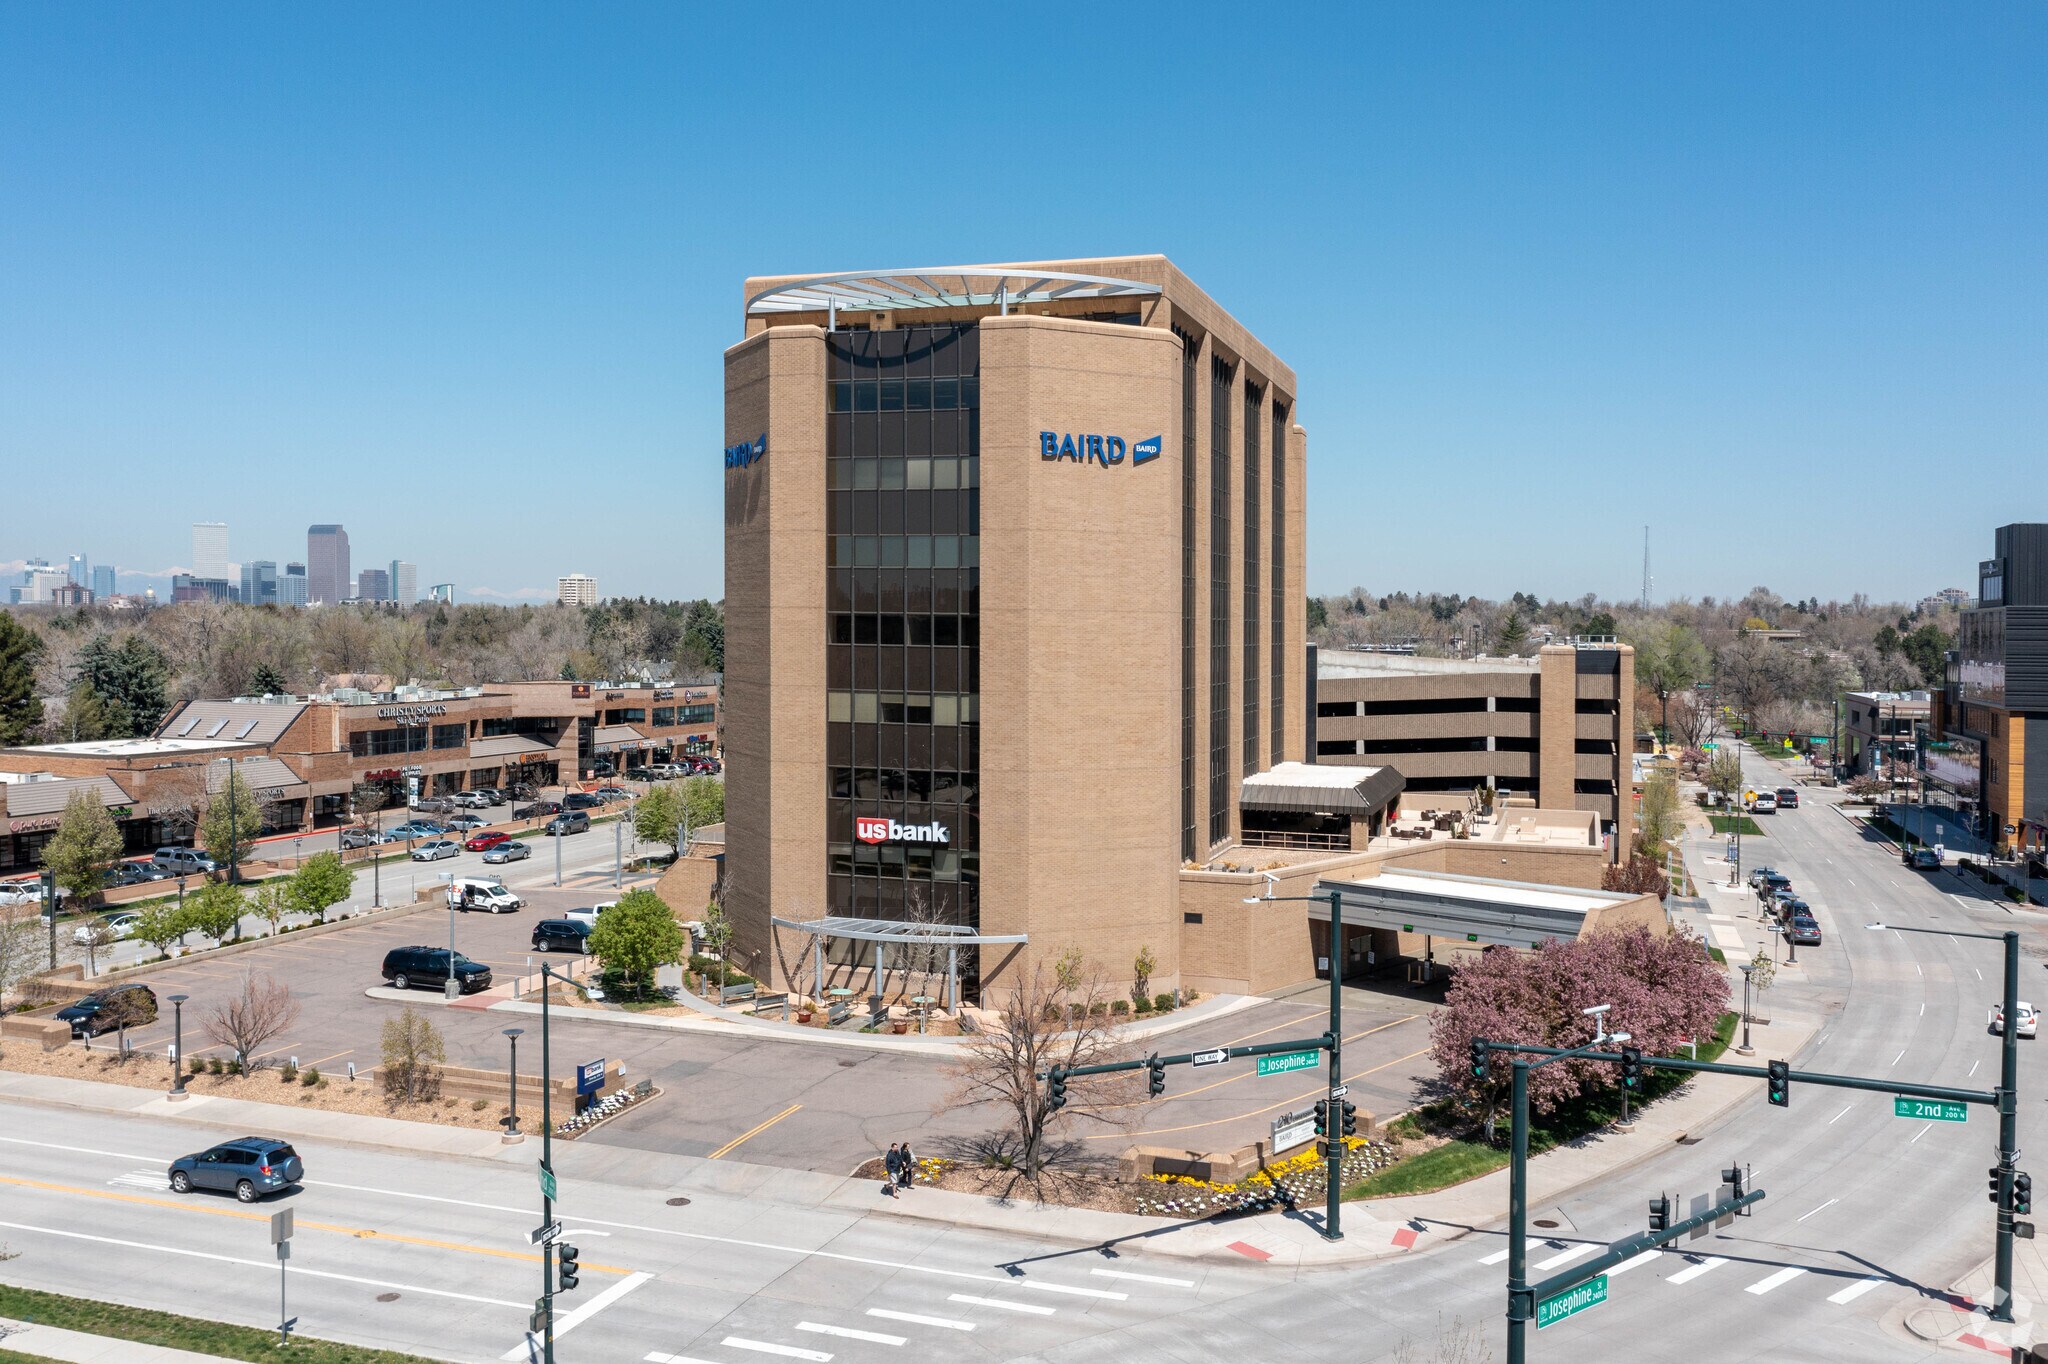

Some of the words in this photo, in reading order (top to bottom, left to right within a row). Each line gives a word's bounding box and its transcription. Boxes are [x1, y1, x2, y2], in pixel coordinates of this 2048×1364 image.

[1040, 431, 1127, 464] BAIRD
[1136, 445, 1157, 454] BAIRD
[378, 706, 415, 717] CHRISTY
[416, 704, 447, 715] SPORTS
[397, 716, 407, 725] Ski
[414, 714, 430, 723] Patio
[858, 819, 949, 843] usbank
[1196, 1054, 1207, 1064] ONE
[1207, 1053, 1219, 1063] WAY
[1267, 1055, 1306, 1072] Josephine
[1915, 1103, 1942, 1117] 2nd
[1597, 1281, 1603, 1290] St
[1592, 1290, 1604, 1301] 2400
[1603, 1288, 1607, 1297] E
[1549, 1287, 1592, 1319] Josephine
